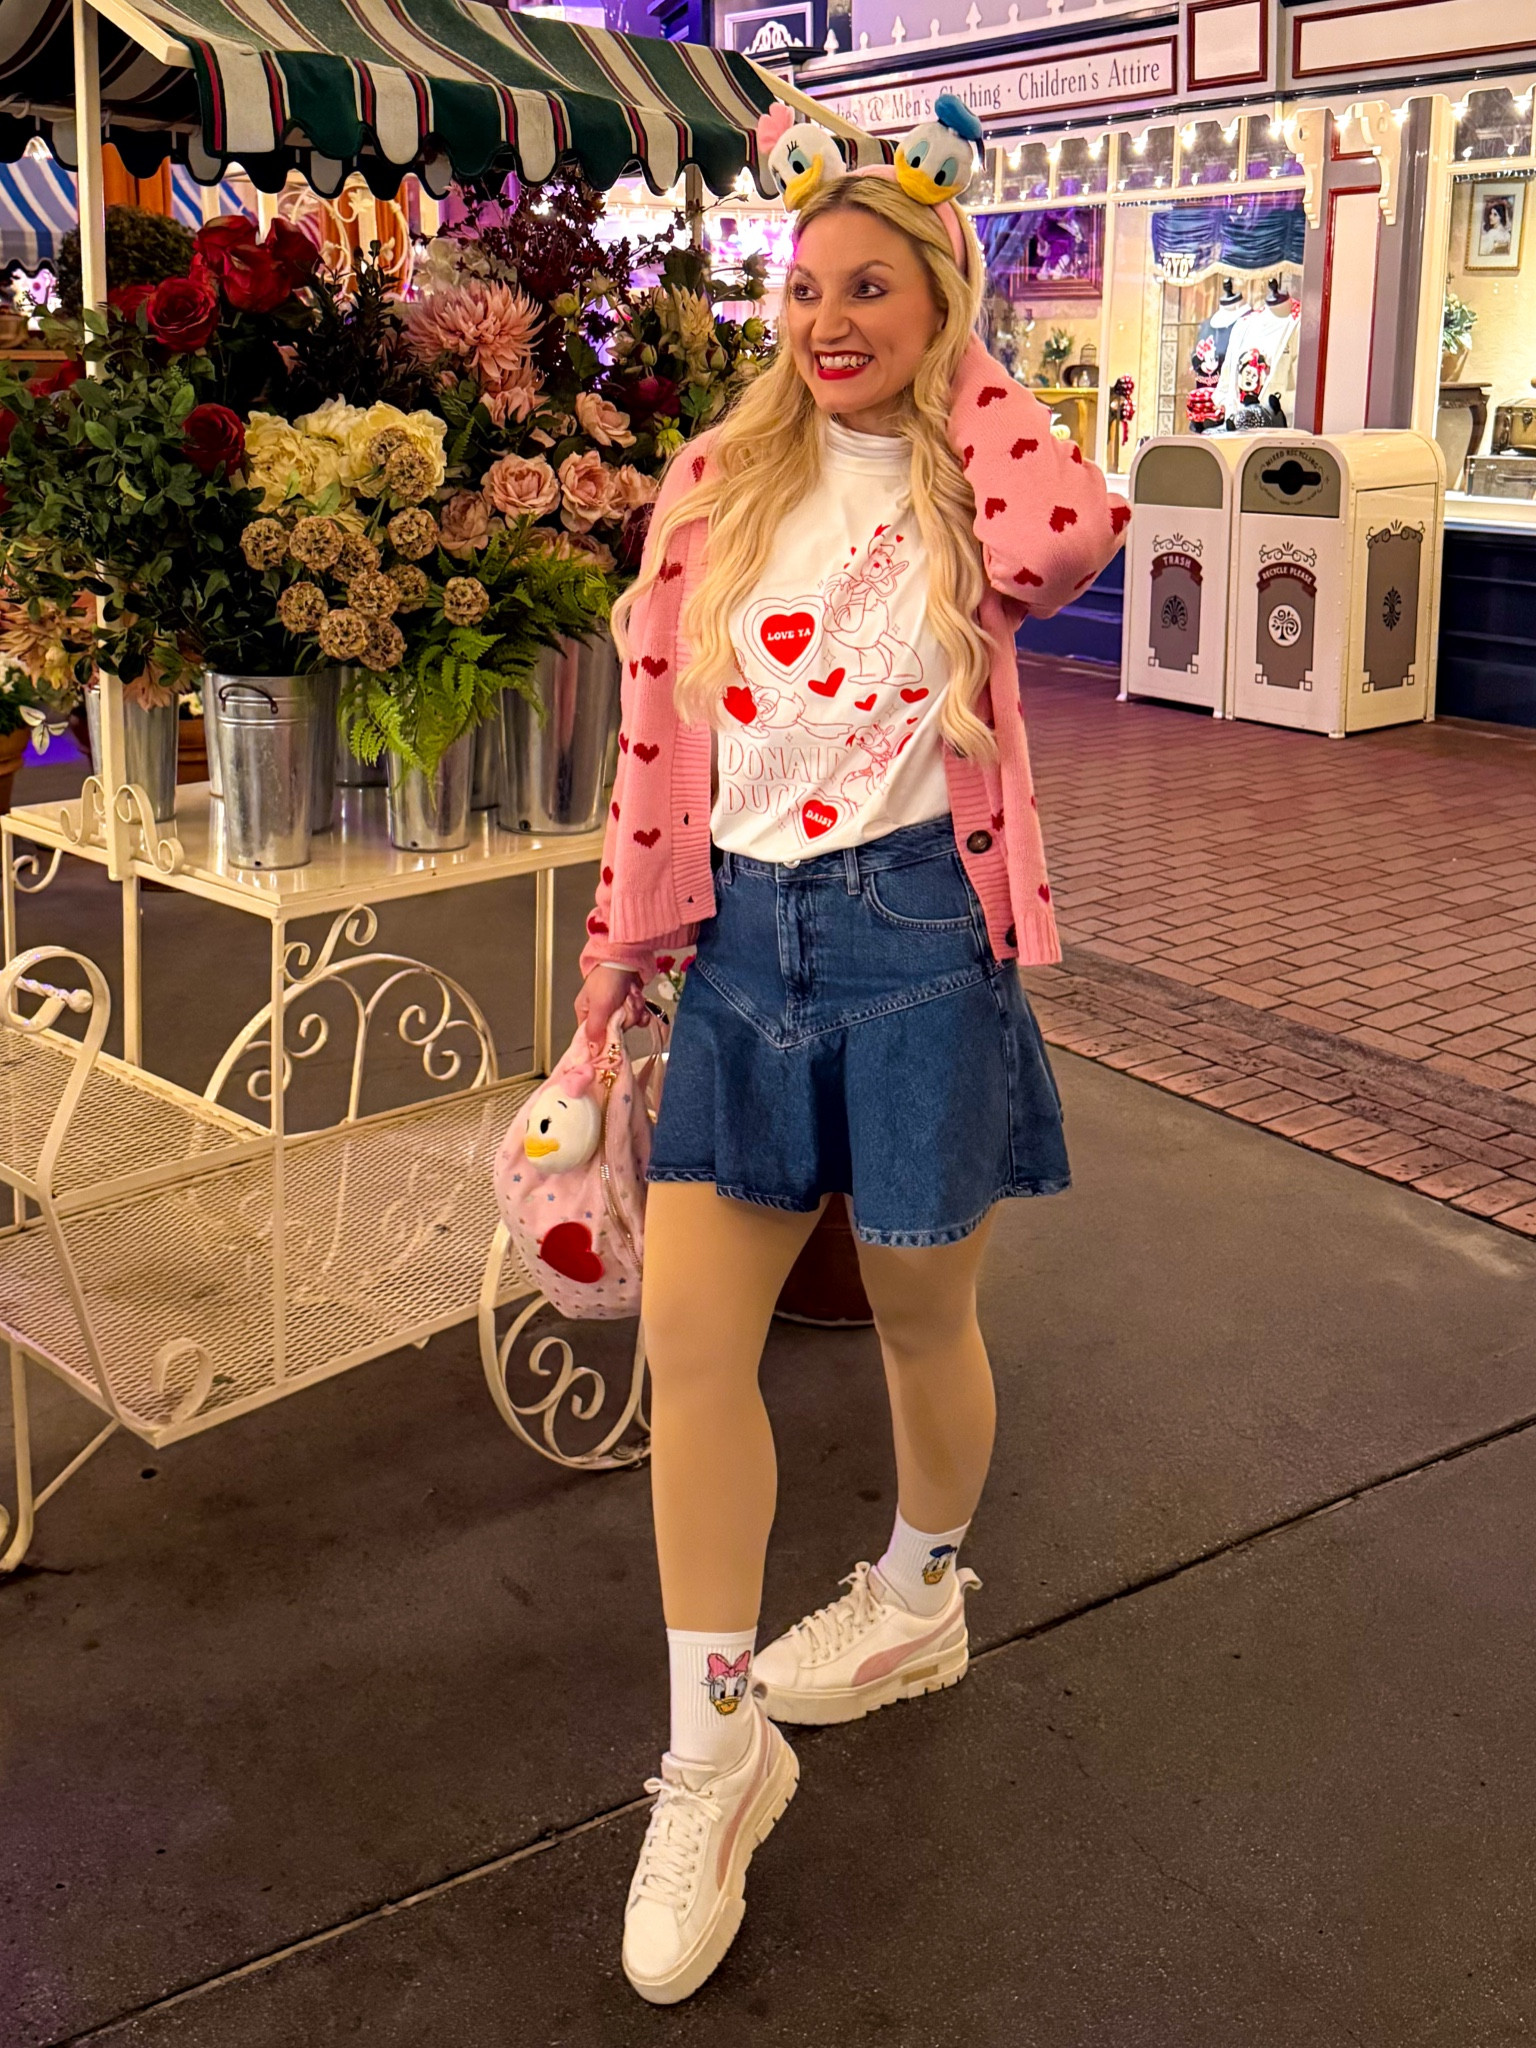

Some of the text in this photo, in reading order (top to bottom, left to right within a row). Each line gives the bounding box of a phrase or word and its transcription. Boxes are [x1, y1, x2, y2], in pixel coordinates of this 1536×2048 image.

[891, 89, 931, 119] Men's
[940, 82, 1001, 110] thing
[1018, 61, 1099, 101] Children's
[1107, 58, 1160, 88] Attire
[1265, 449, 1319, 469] MIXED RECYCLING
[1162, 556, 1192, 570] TRASH
[1261, 566, 1313, 584] RECYCLE PLEASE
[767, 627, 811, 641] LOVE YA
[805, 809, 834, 828] DAISY
